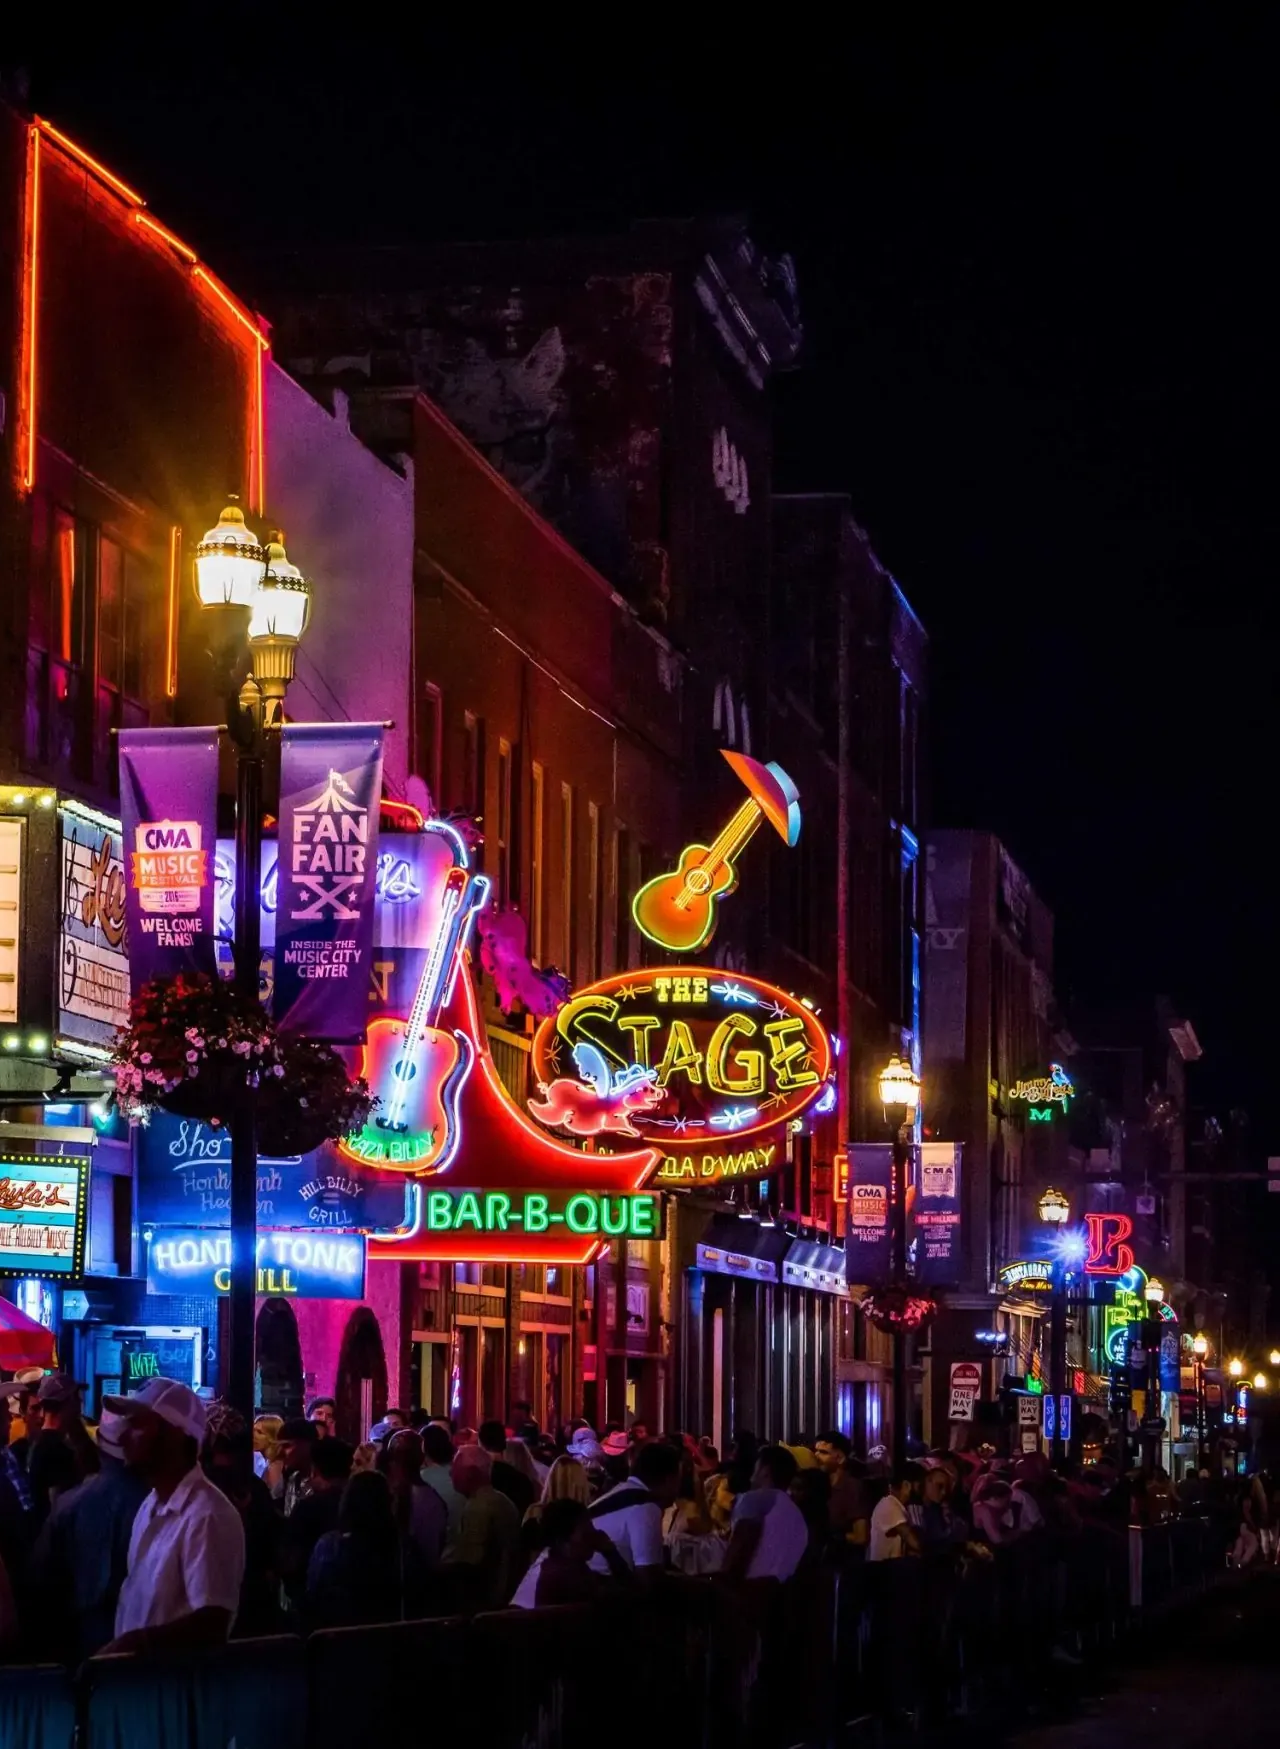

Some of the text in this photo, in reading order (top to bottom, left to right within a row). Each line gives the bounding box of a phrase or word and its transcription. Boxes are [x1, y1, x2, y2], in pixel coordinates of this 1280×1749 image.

[293, 814, 368, 843] FAN
[145, 828, 192, 850] CMA
[140, 855, 199, 875] MUSIC
[292, 844, 366, 873] FAIR
[141, 874, 199, 885] FESTIVAL
[140, 918, 203, 933] WELCOME
[290, 939, 357, 950] INSIDE THE
[284, 950, 362, 964] MUSIC CITY
[297, 964, 349, 978] CENTER
[655, 976, 709, 1003] THE
[556, 995, 821, 1096] STAGE
[298, 1176, 364, 1202] HILL BILLY
[857, 1188, 882, 1198] CMA
[308, 1206, 353, 1226] GRILL
[427, 1193, 655, 1236] BAR-B-QUE
[15, 1228, 43, 1249] HILLBILLY
[47, 1229, 69, 1250] MUSIC
[852, 1228, 886, 1236] WELCOME
[271, 1236, 361, 1275] TONK
[214, 1267, 298, 1293] GILL
[952, 1399, 971, 1408] WAY
[953, 1390, 971, 1399] ONE
[1021, 1406, 1038, 1414] WAY
